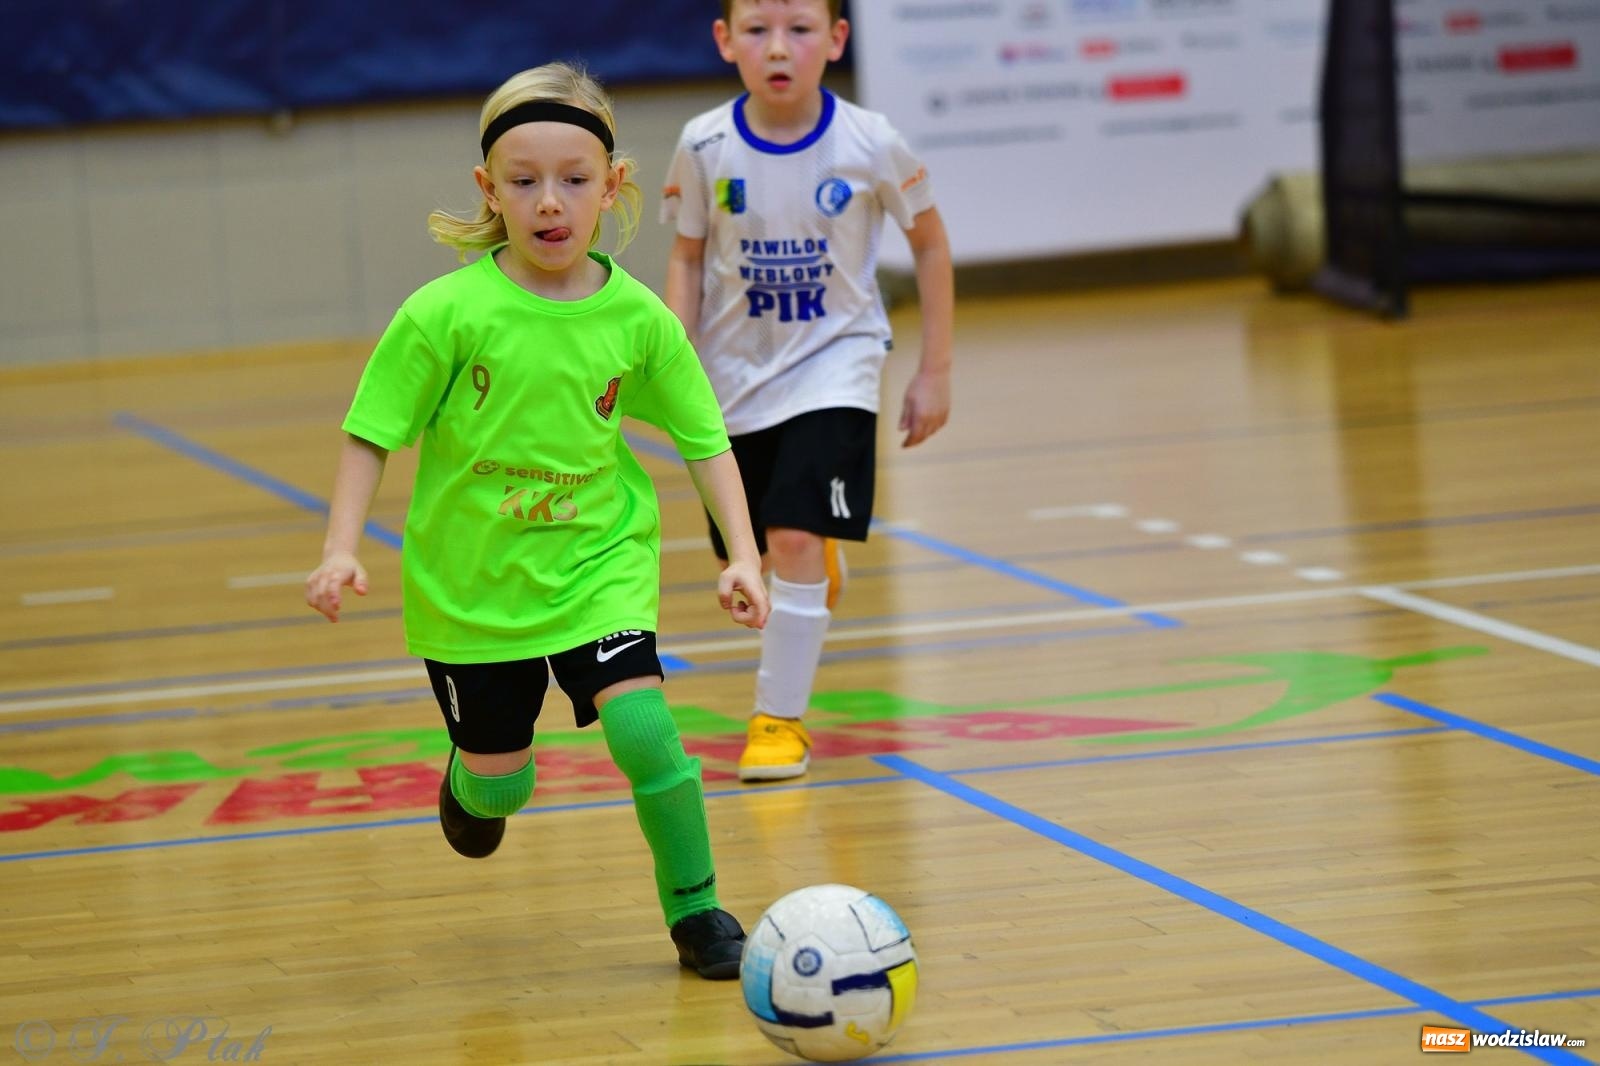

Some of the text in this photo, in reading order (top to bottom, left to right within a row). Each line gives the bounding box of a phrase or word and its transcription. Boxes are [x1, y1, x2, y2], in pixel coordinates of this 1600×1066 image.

[746, 287, 827, 322] PIK
[472, 364, 491, 411] 9
[445, 675, 461, 723] 9
